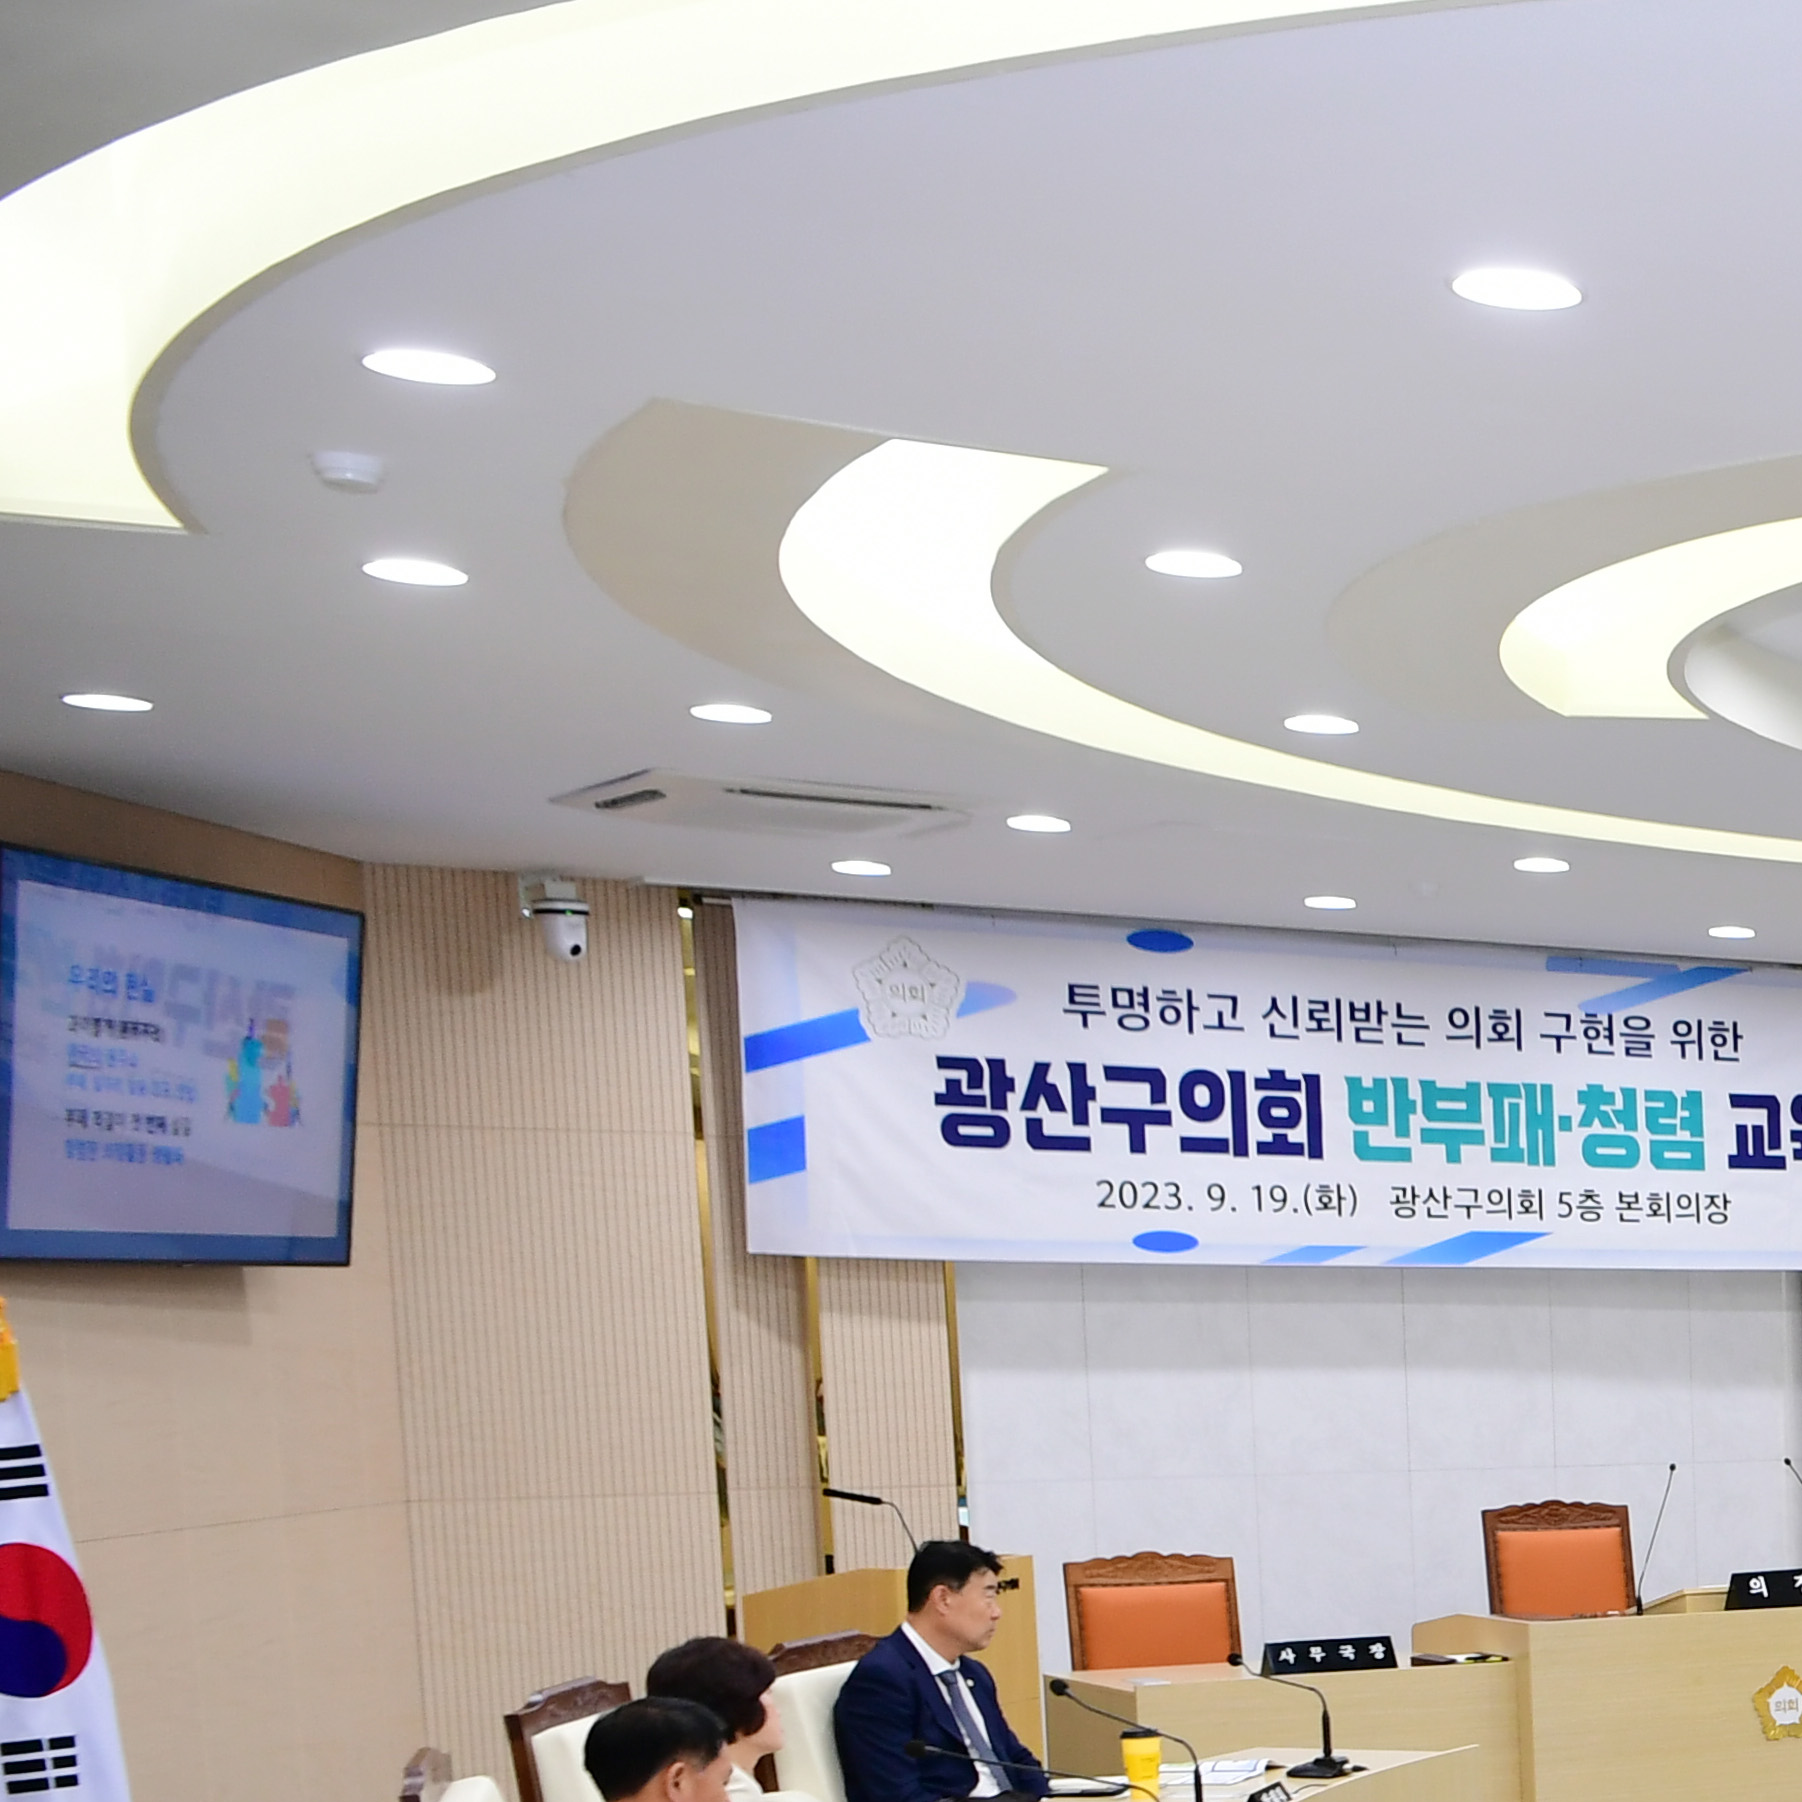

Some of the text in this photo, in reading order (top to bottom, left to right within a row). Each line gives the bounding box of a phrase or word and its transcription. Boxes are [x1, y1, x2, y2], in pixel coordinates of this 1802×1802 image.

[1062, 983, 1744, 1063] 투명하고 신뢰받는 의회 구현을 위한
[933, 1054, 1325, 1161] 광산구의회
[1095, 1179, 1732, 1225] 2023. 9. 19.(화) 광산구의회 5층 본회의장
[1279, 1642, 1386, 1665] 사무국장
[1774, 1698, 1799, 1713] 의회
